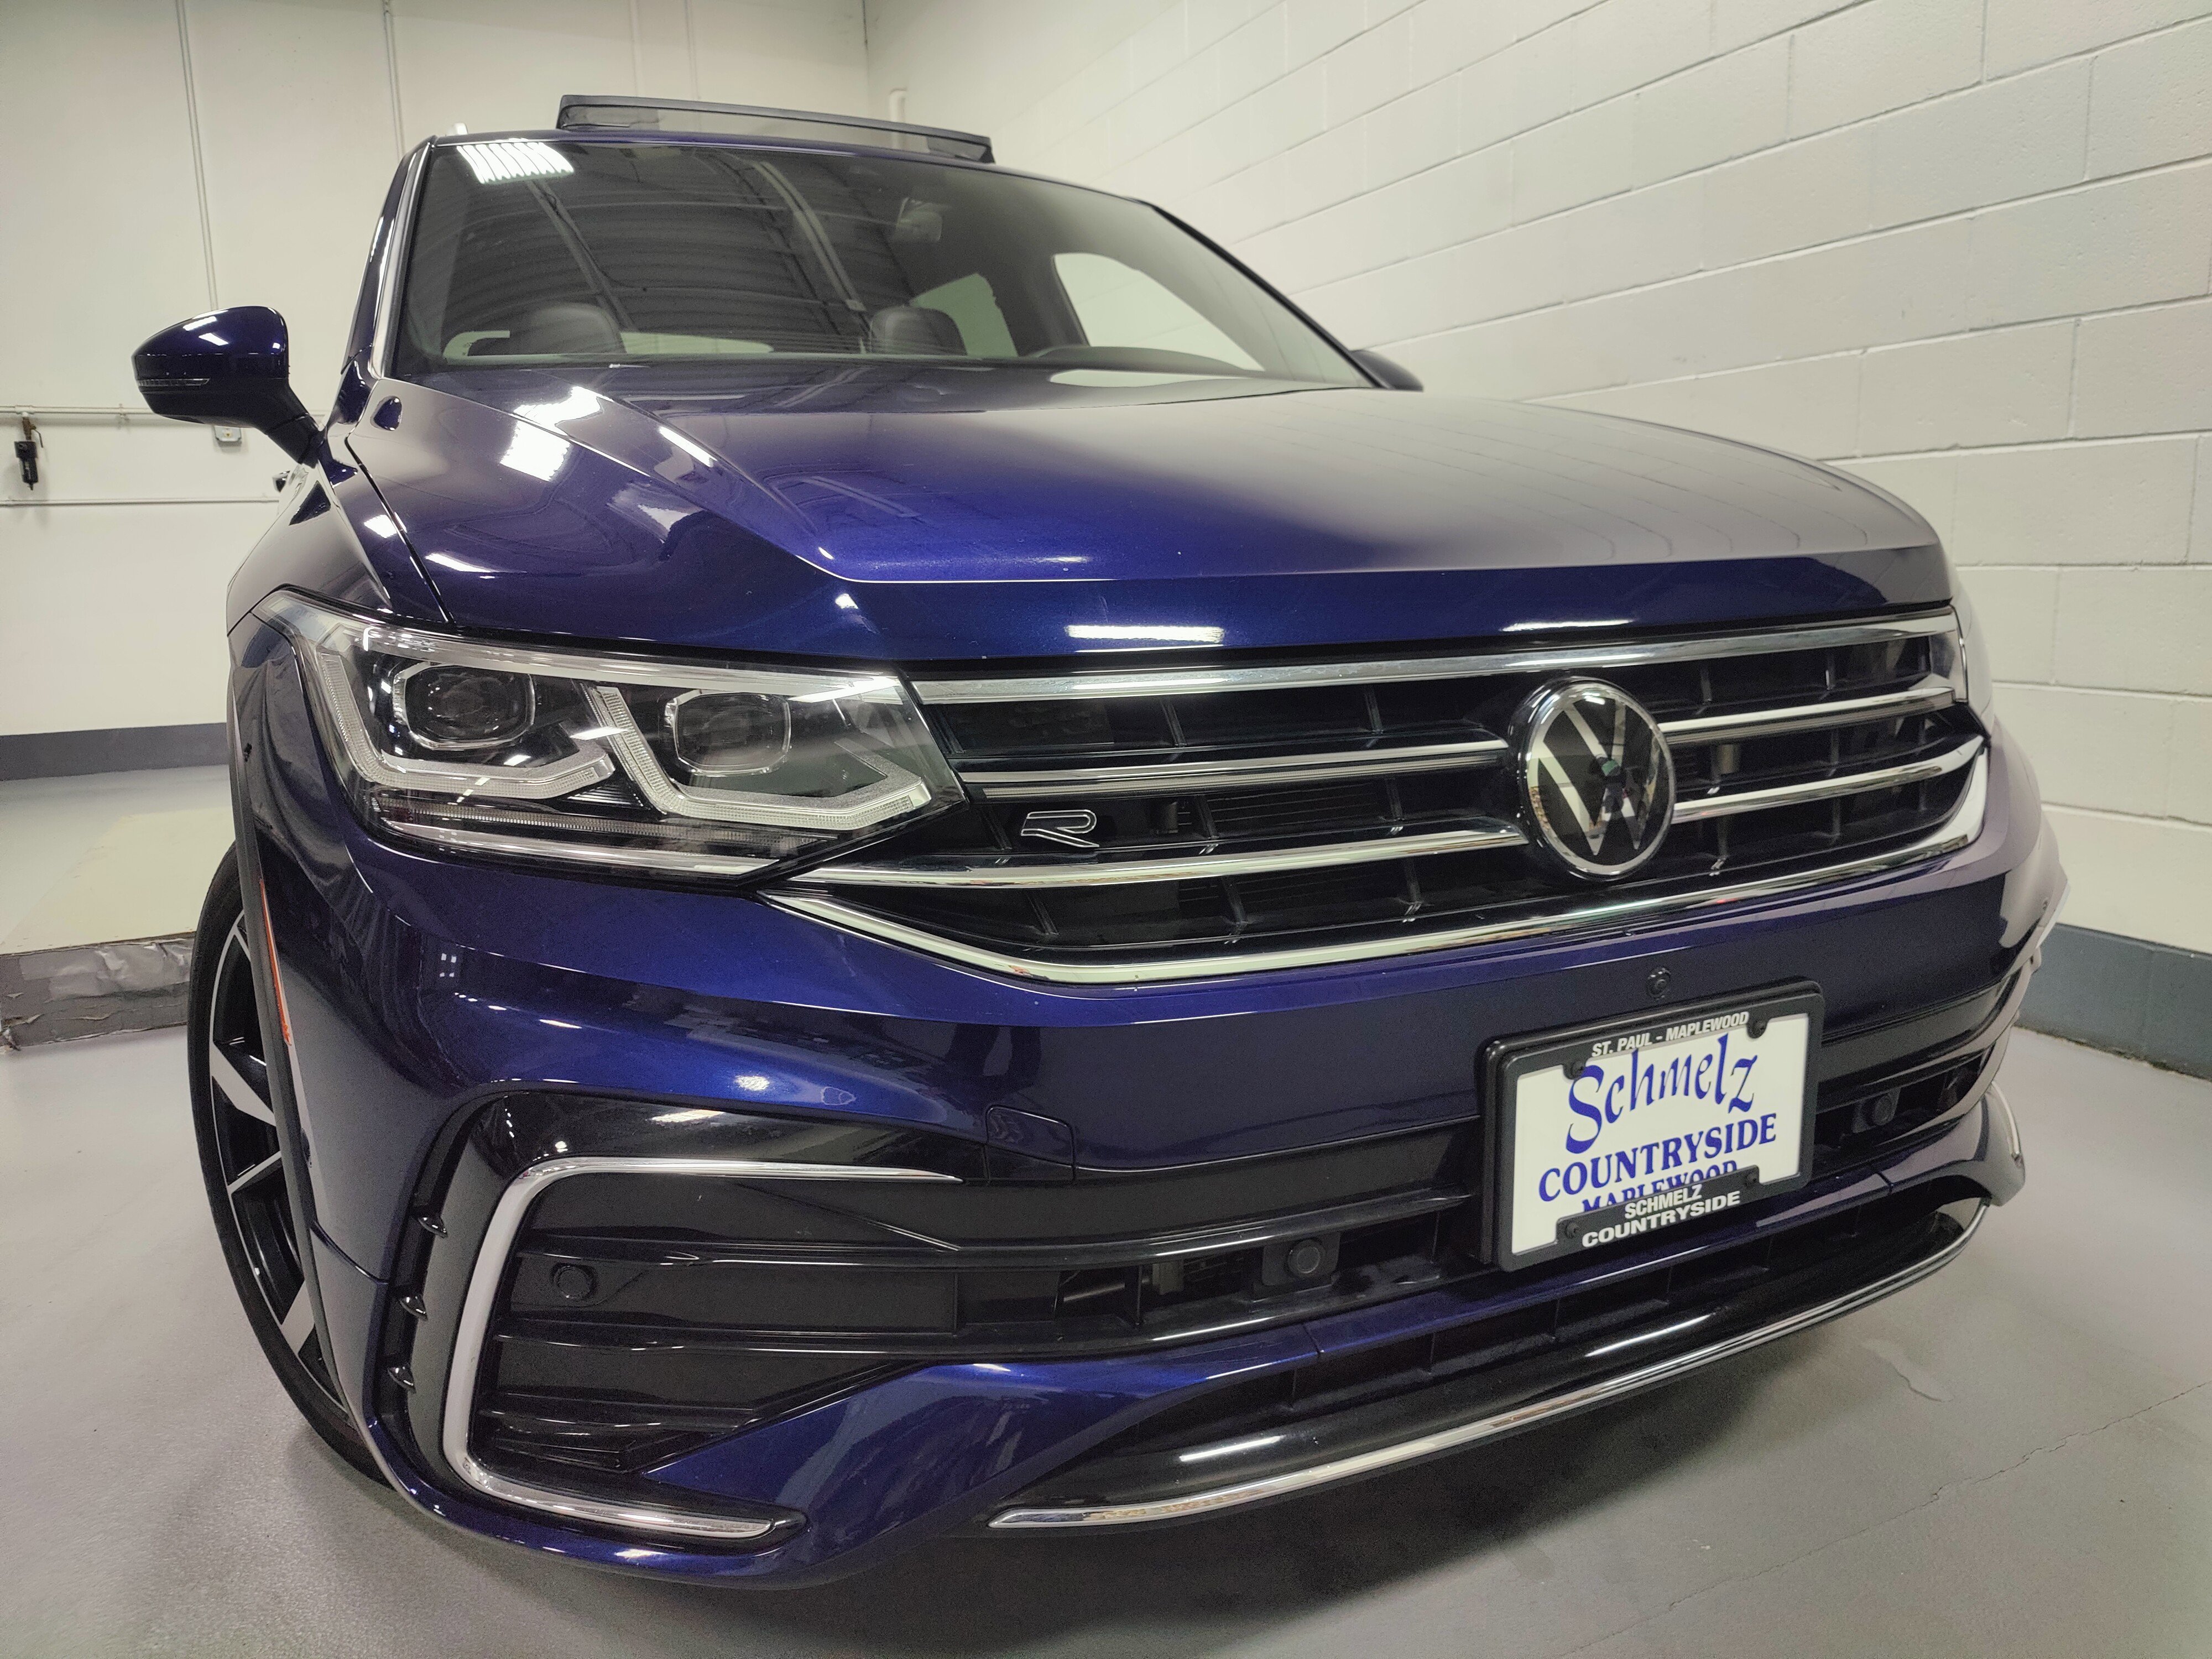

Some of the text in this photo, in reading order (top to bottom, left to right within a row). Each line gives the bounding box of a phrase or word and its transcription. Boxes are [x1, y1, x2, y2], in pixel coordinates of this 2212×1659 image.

[1021, 809, 1099, 848] R
[1591, 1042, 1614, 1057] ST.
[1616, 1032, 1653, 1052] PAUL
[1666, 1011, 1749, 1041] MAPLEWOOD
[1566, 1033, 1758, 1154] Schmelz
[1538, 1113, 1777, 1202] COUNTRYSIDE
[1582, 1191, 1741, 1248] COUNTRYSIDE
[1625, 1184, 1702, 1219] SCHMELZ
